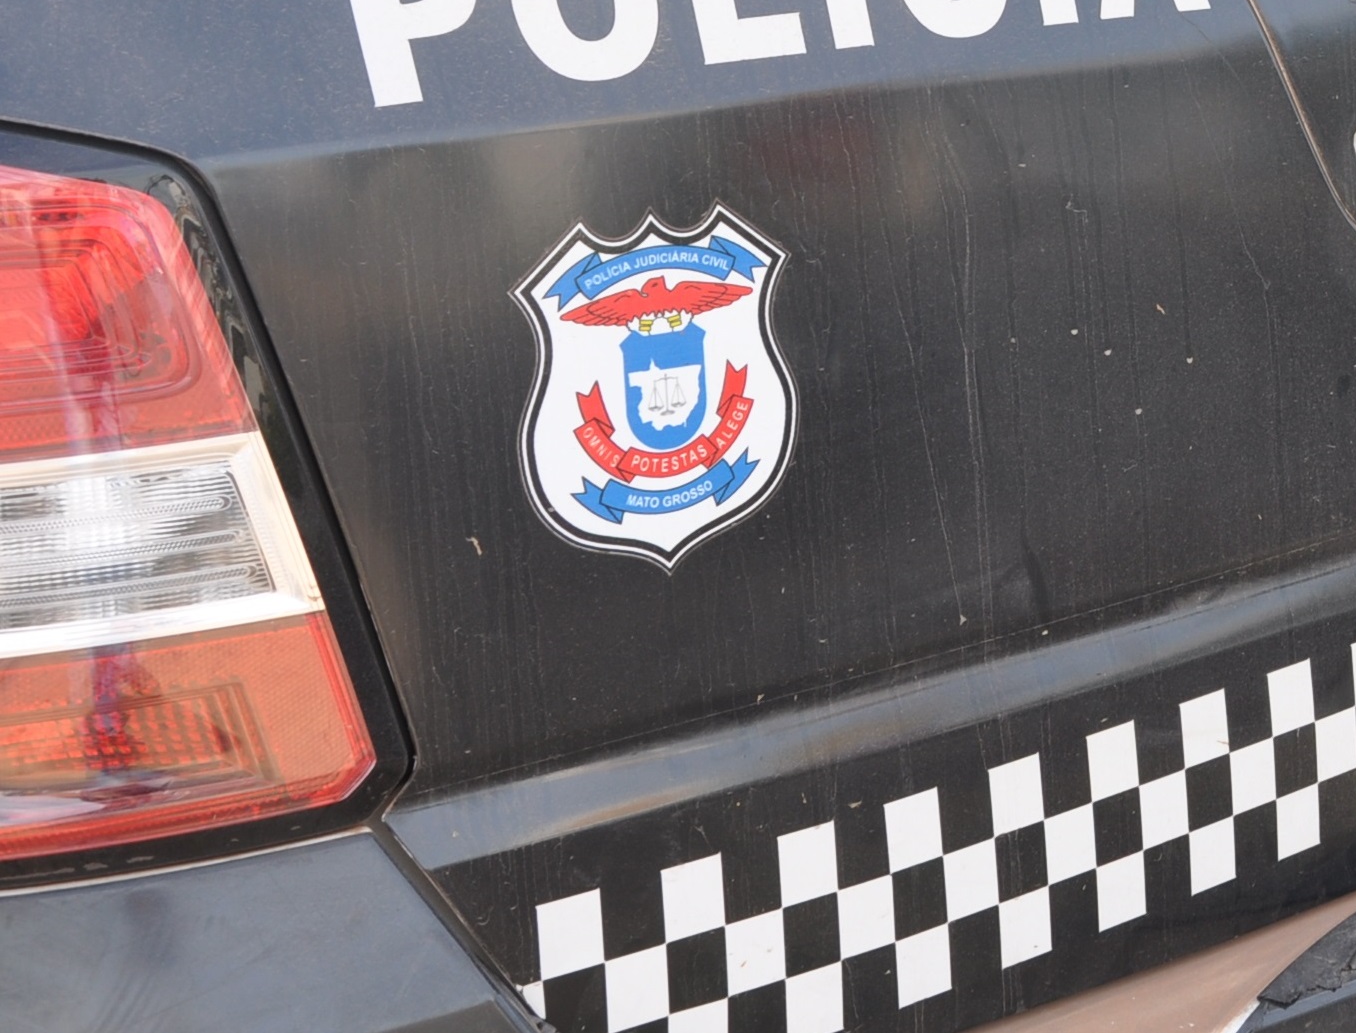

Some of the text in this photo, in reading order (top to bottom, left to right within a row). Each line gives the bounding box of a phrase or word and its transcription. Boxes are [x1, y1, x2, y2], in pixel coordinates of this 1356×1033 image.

[584, 250, 729, 290] POLÍCIA JUDICIÁRIA CIVIL
[583, 426, 620, 468] OMNIS
[630, 444, 708, 473] POTESTAS
[626, 479, 713, 509] MATO GROSSO
